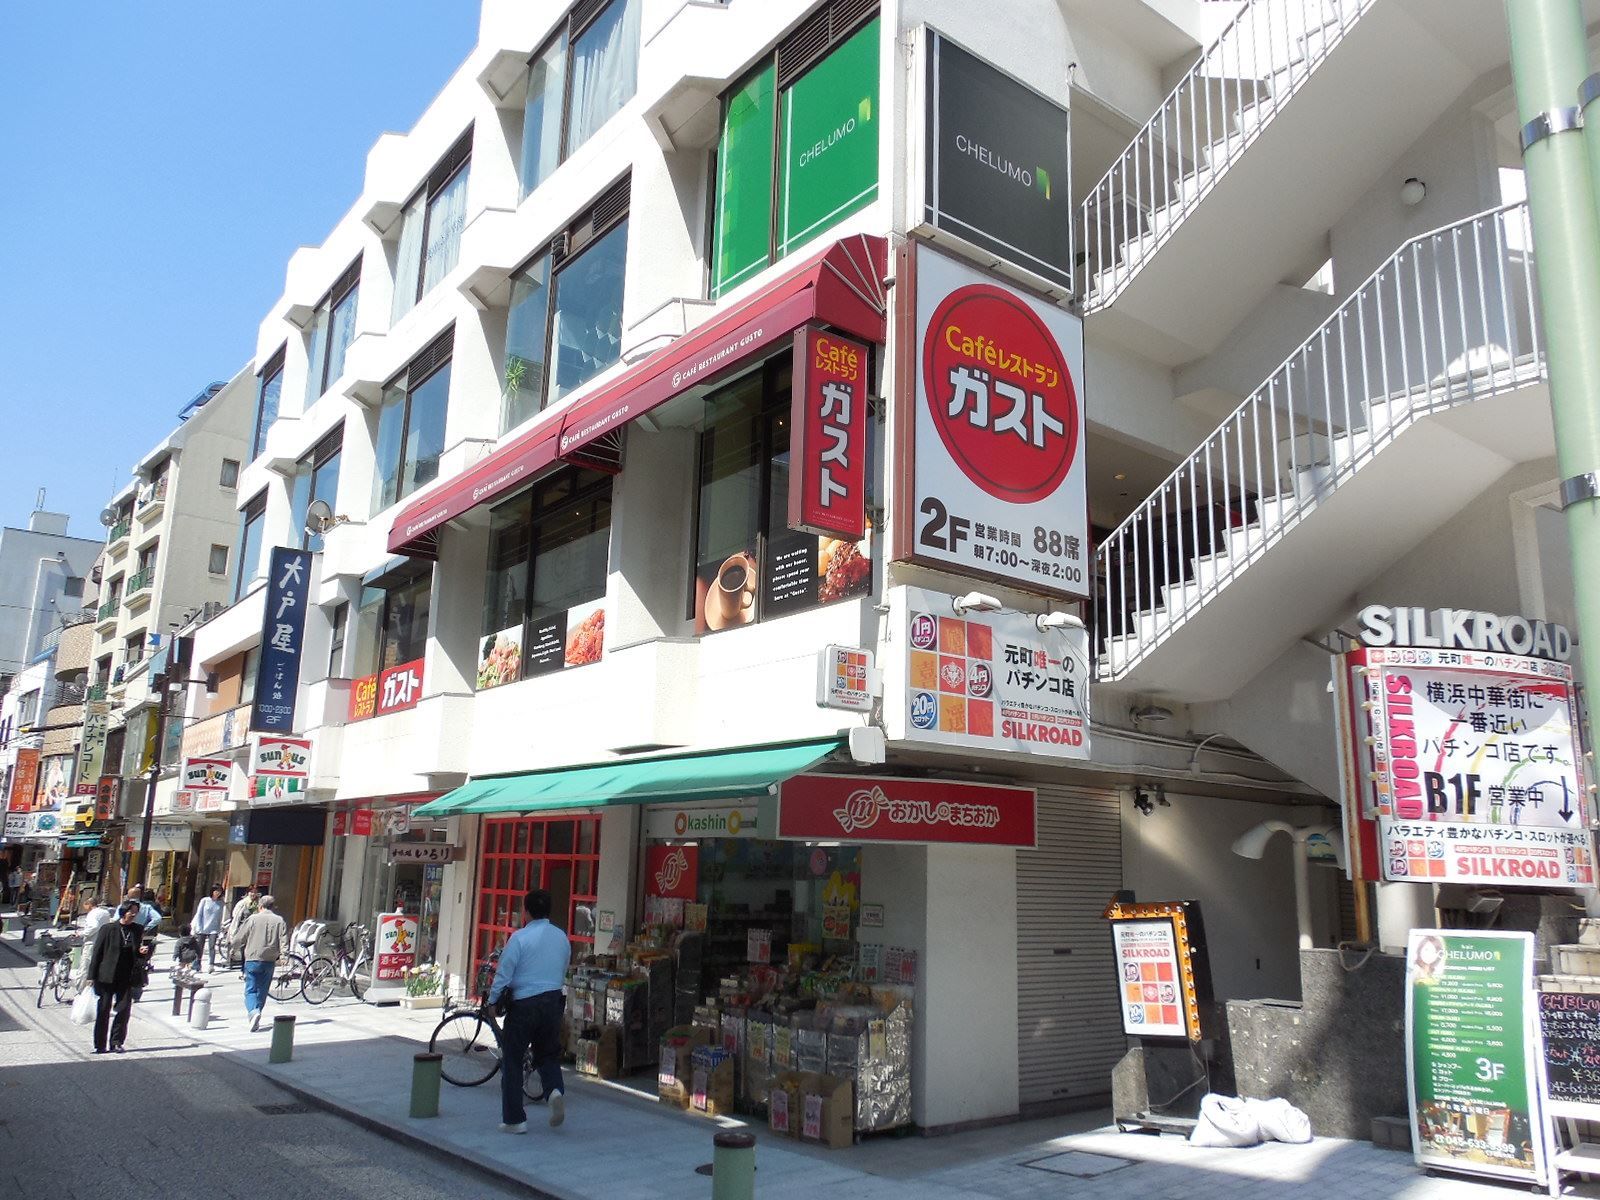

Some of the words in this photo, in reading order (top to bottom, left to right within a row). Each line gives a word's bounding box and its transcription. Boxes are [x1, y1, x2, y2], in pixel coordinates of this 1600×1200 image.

[799, 117, 856, 168] CHELUMO
[955, 134, 1033, 188] CHELUMO
[698, 341, 739, 371] RESTAURANT
[740, 328, 763, 347] GUSTO
[815, 337, 859, 368] Café
[814, 355, 858, 381] レストラン
[947, 365, 1065, 449] ガスト
[819, 380, 852, 508] ガスト
[920, 496, 971, 553] 2F
[974, 522, 1022, 548] 営業時間
[1033, 525, 1080, 561] 88席
[271, 555, 303, 654] 大戸屋
[914, 617, 931, 636] 1円
[1358, 604, 1572, 661] SILKROAD
[1004, 644, 1075, 674] 元町唯一の
[1438, 652, 1538, 674] 元町唯一のパチンコ店
[355, 677, 377, 702] Café
[381, 669, 420, 710] ガスト
[970, 666, 988, 684] 4円
[1006, 669, 1075, 698] パチンコ店
[1427, 681, 1544, 710] 横浜中華街に
[266, 715, 282, 724] 2F
[1002, 720, 1083, 747] SILKROAD
[1449, 710, 1528, 735] 一番近い
[80, 714, 100, 782] バナナレコード
[1386, 674, 1424, 820] SILKROAD
[78, 785, 96, 794] 2F
[1424, 771, 1481, 816] B1F
[1488, 784, 1545, 809] 営業中
[889, 800, 1000, 827] おかしのまちおか
[1456, 856, 1561, 880] SILKROAD
[1122, 948, 1170, 958] SILKROAD
[1475, 1057, 1505, 1081] 3F
